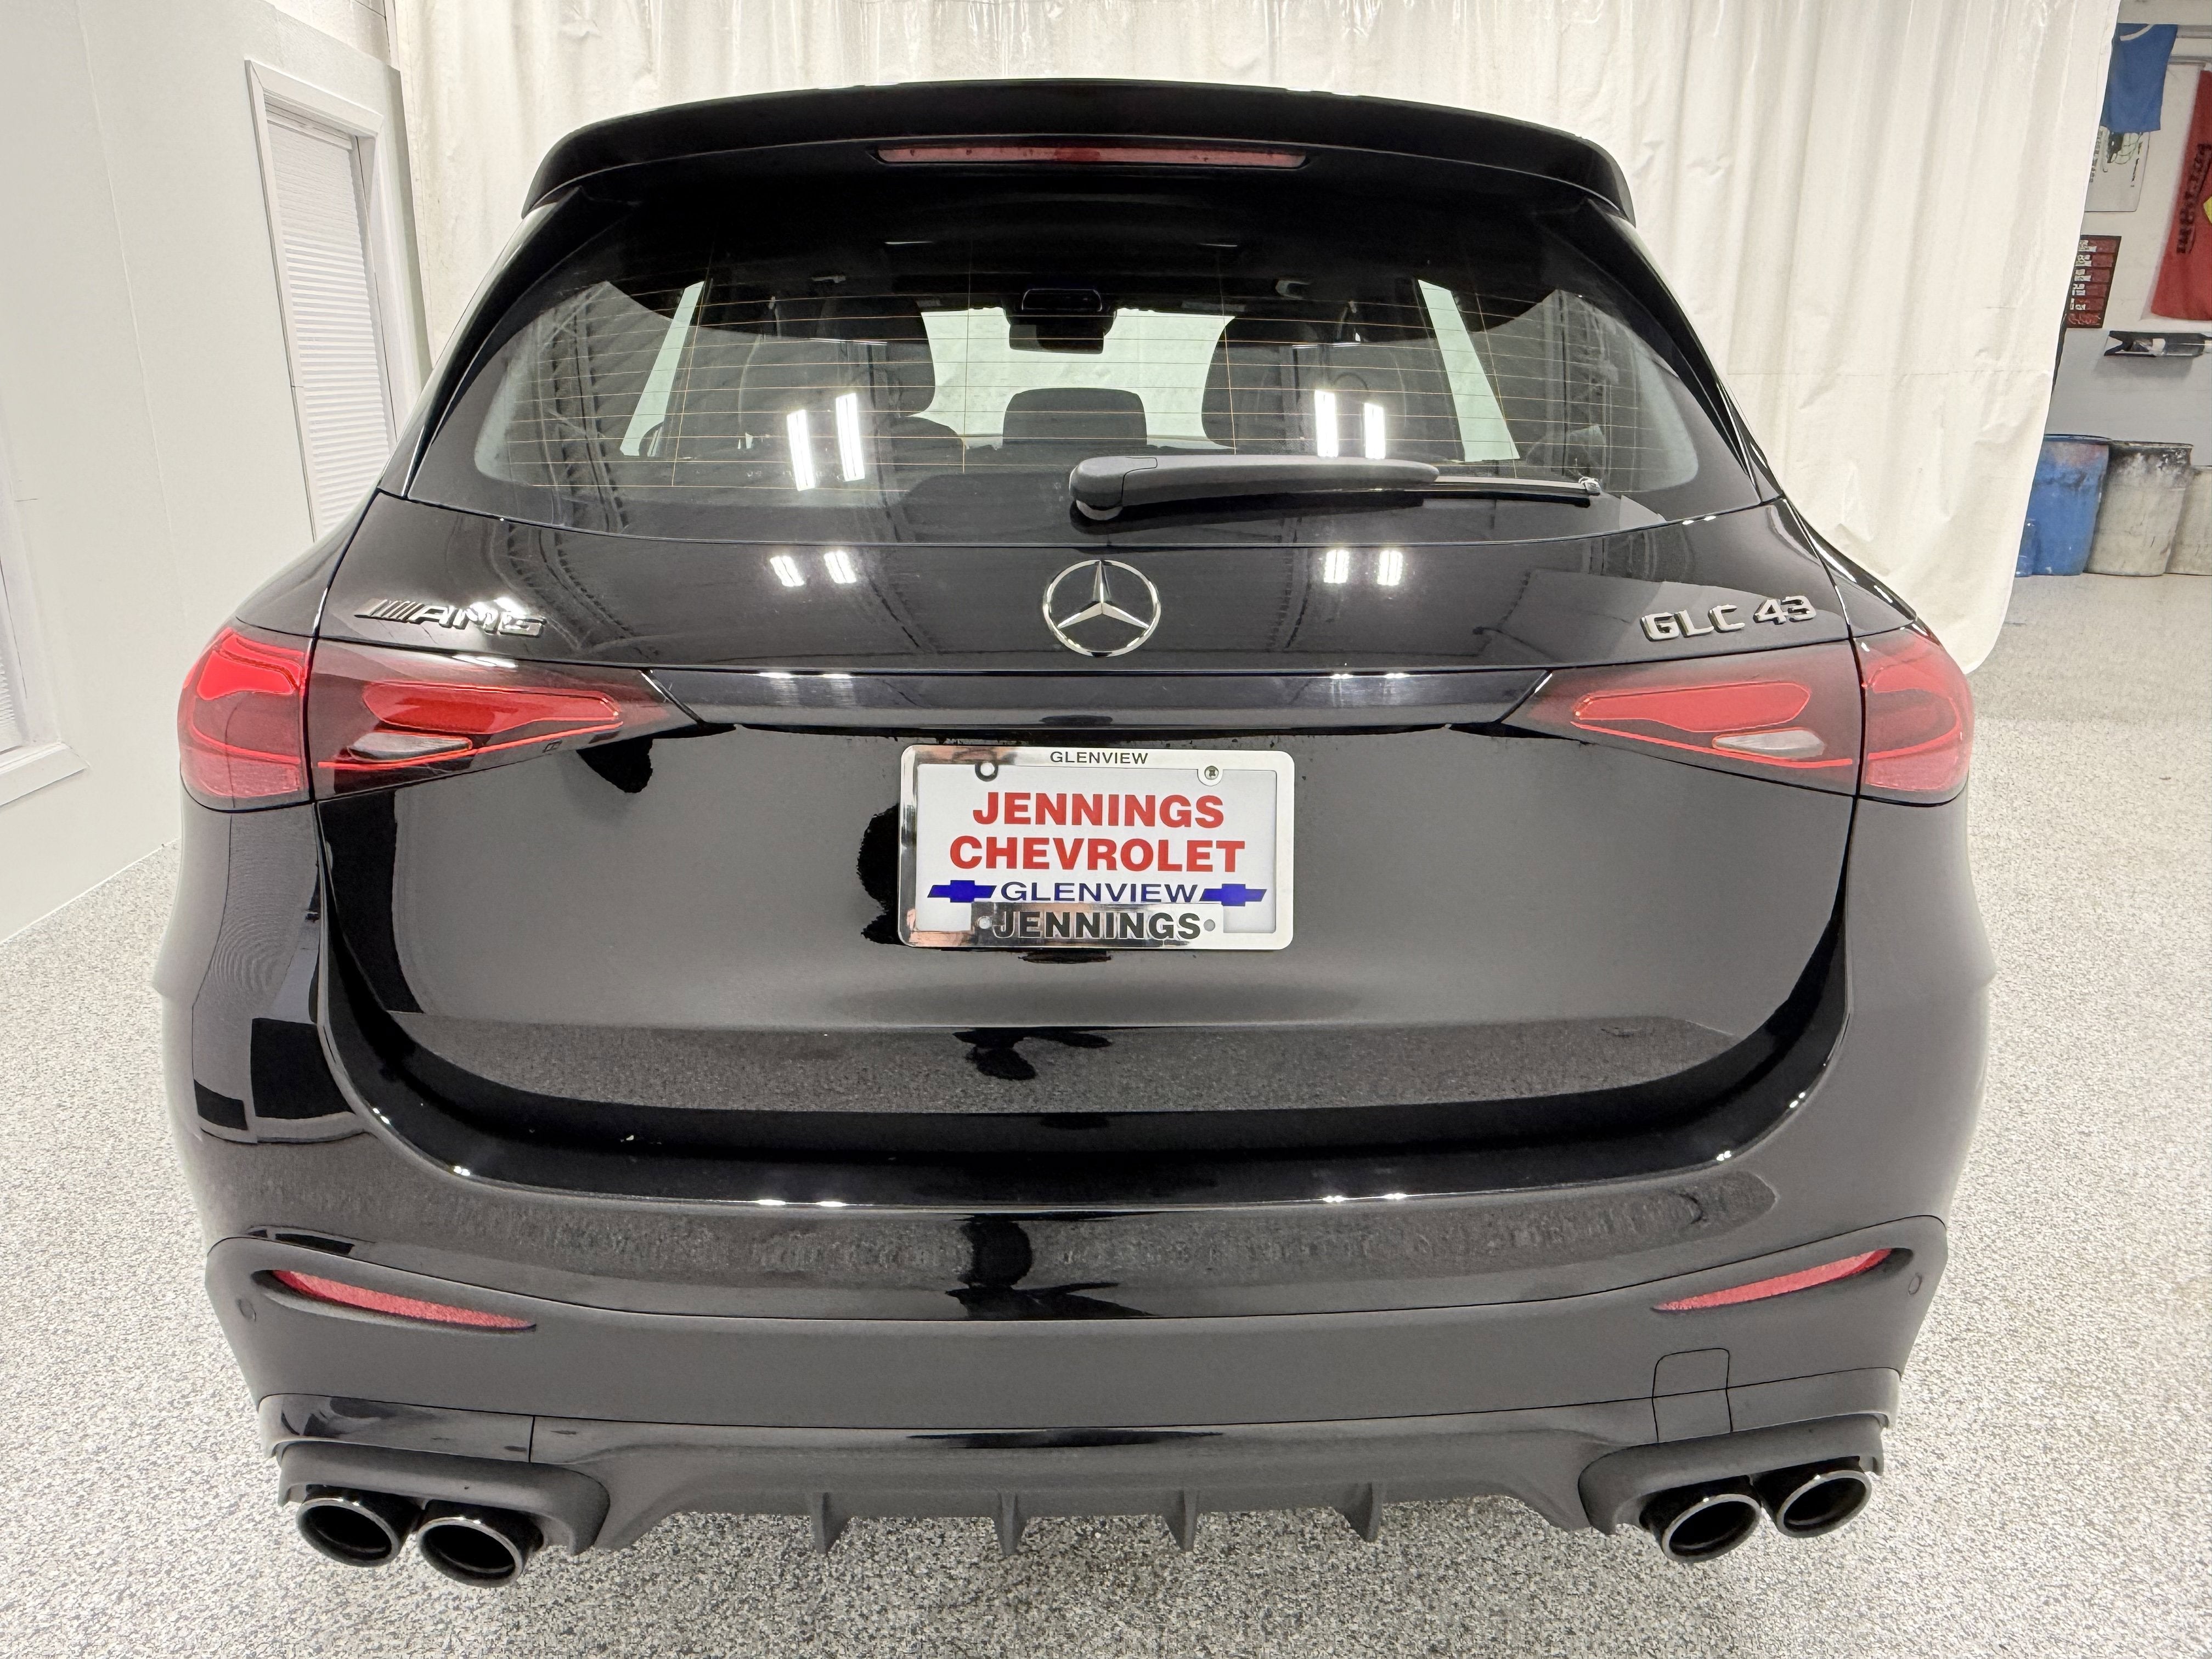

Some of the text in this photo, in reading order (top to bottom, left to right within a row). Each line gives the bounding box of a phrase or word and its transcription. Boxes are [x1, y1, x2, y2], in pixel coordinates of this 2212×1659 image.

[407, 602, 548, 637] AMG
[1640, 595, 1816, 641] GLC 43
[1050, 751, 1149, 765] GLENVIEW
[973, 792, 1224, 828] JENNINGS
[950, 836, 1245, 872] CHEVROLET
[1000, 881, 1199, 902] GLENVIEW
[993, 910, 1201, 940] JENNINGS
